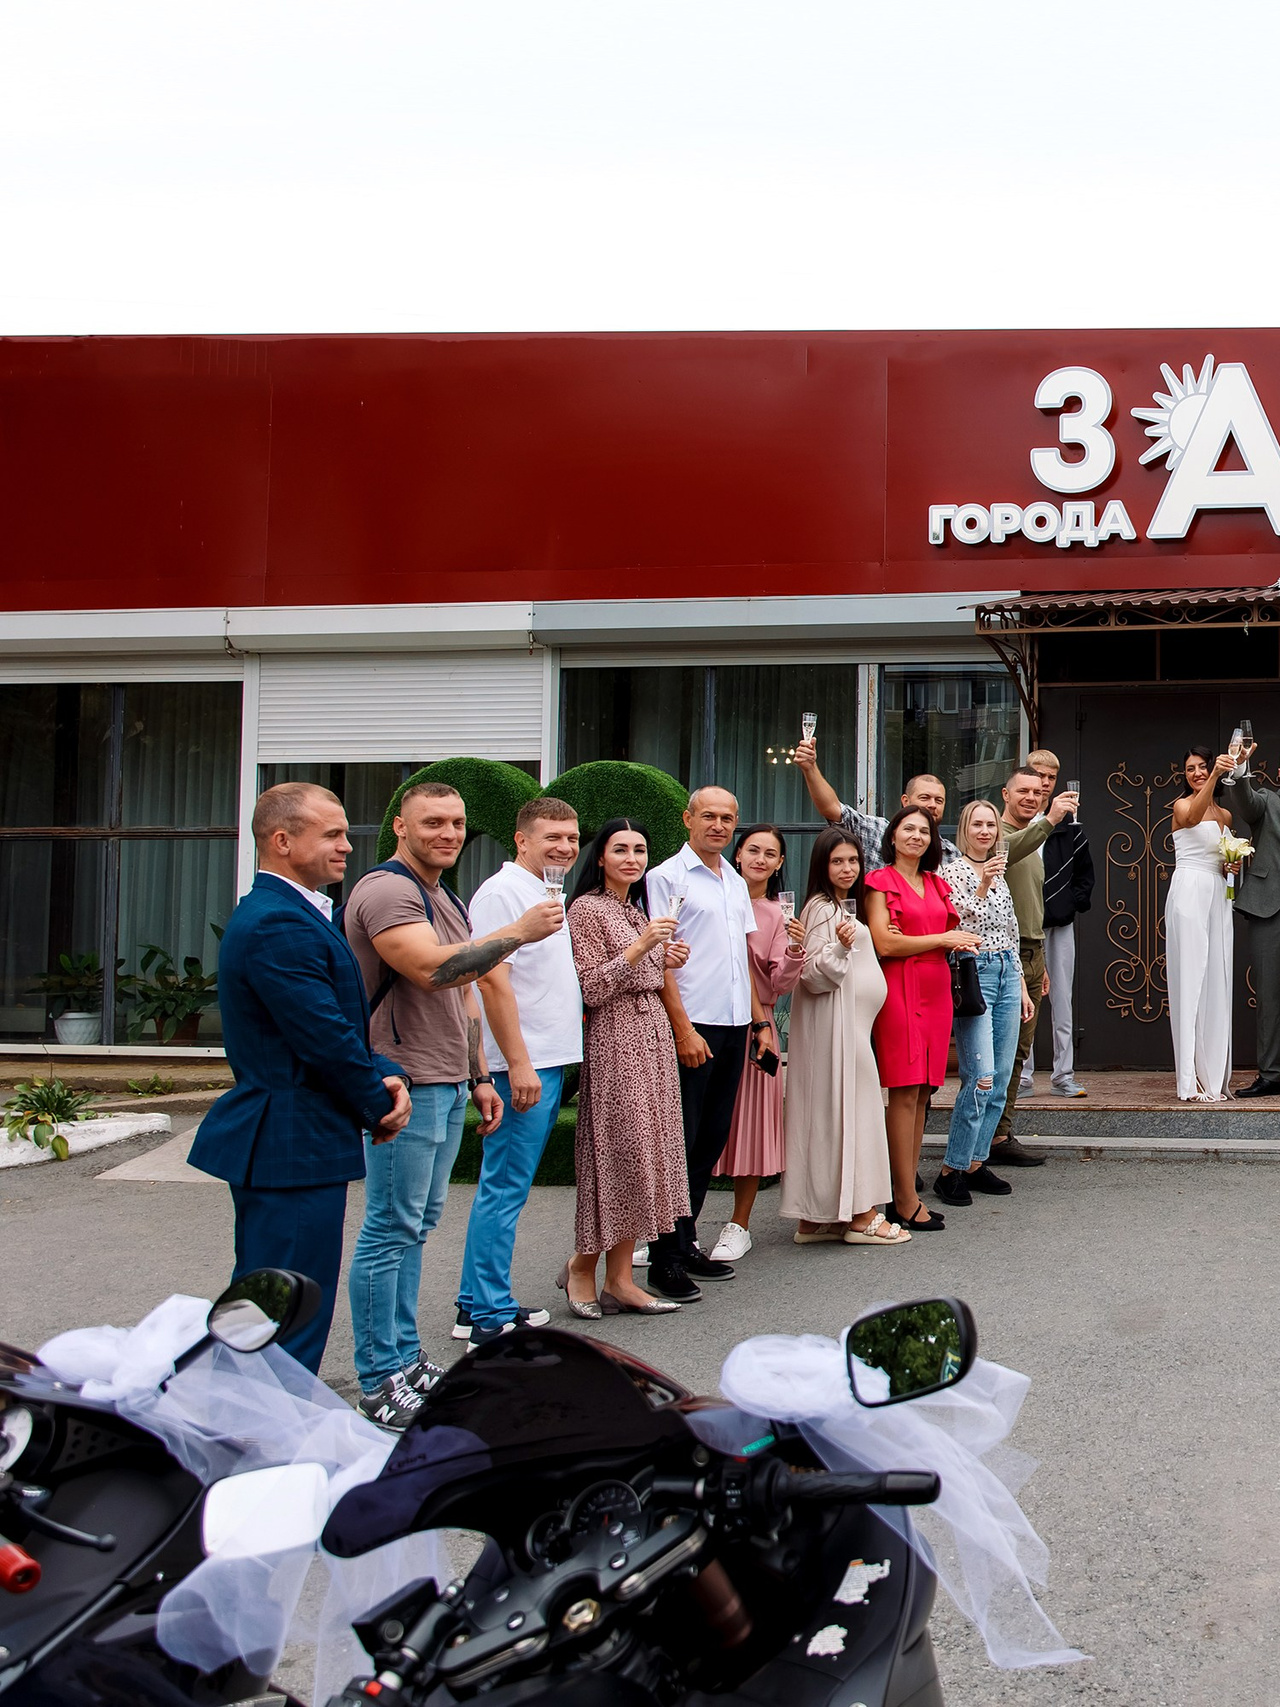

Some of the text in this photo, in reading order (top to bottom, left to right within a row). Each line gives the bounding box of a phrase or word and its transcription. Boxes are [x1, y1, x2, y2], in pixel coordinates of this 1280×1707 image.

[928, 500, 1136, 547] ГОРОДА
[413, 1373, 440, 1391] N
[374, 1404, 397, 1423] N
